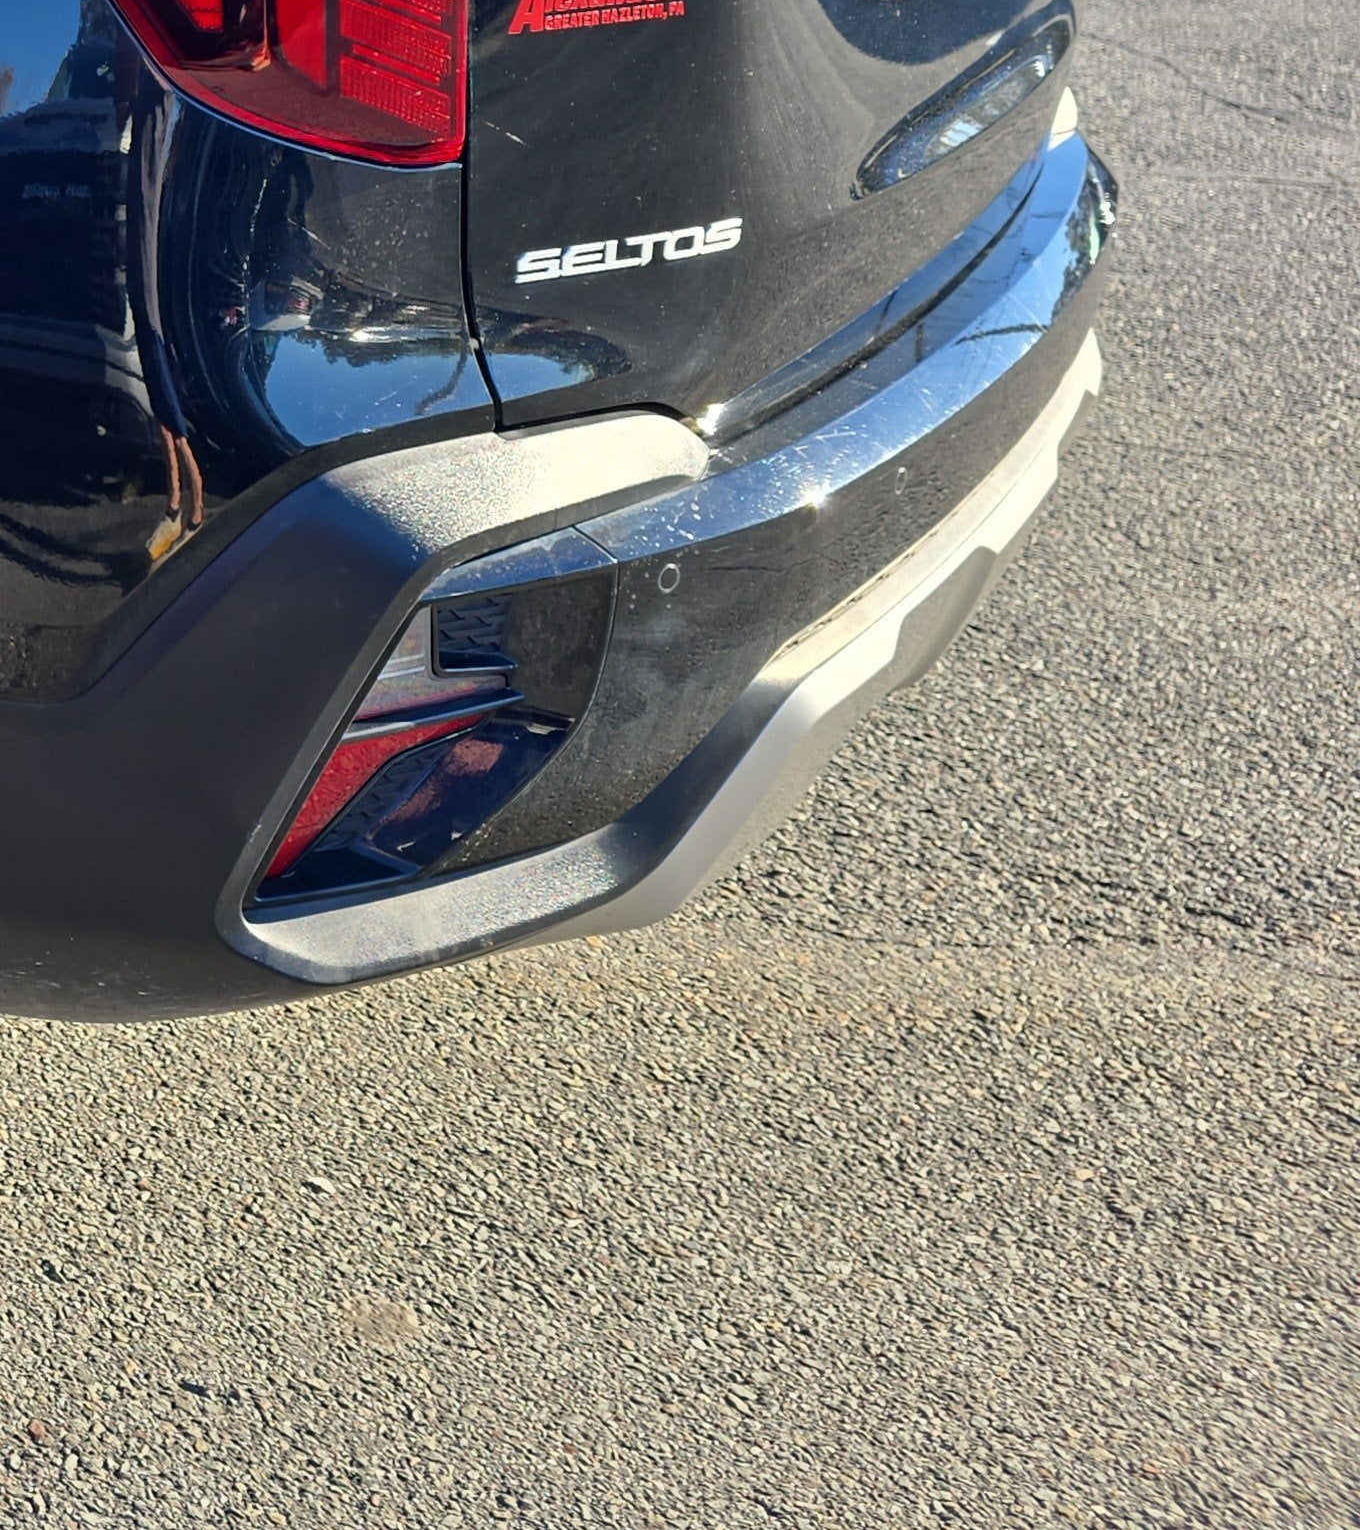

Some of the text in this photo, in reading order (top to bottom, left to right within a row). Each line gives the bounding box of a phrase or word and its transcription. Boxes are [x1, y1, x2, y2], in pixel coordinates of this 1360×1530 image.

[545, 10, 600, 31] GREATER
[669, 0, 685, 16] PA
[514, 217, 743, 285] SELTOS
